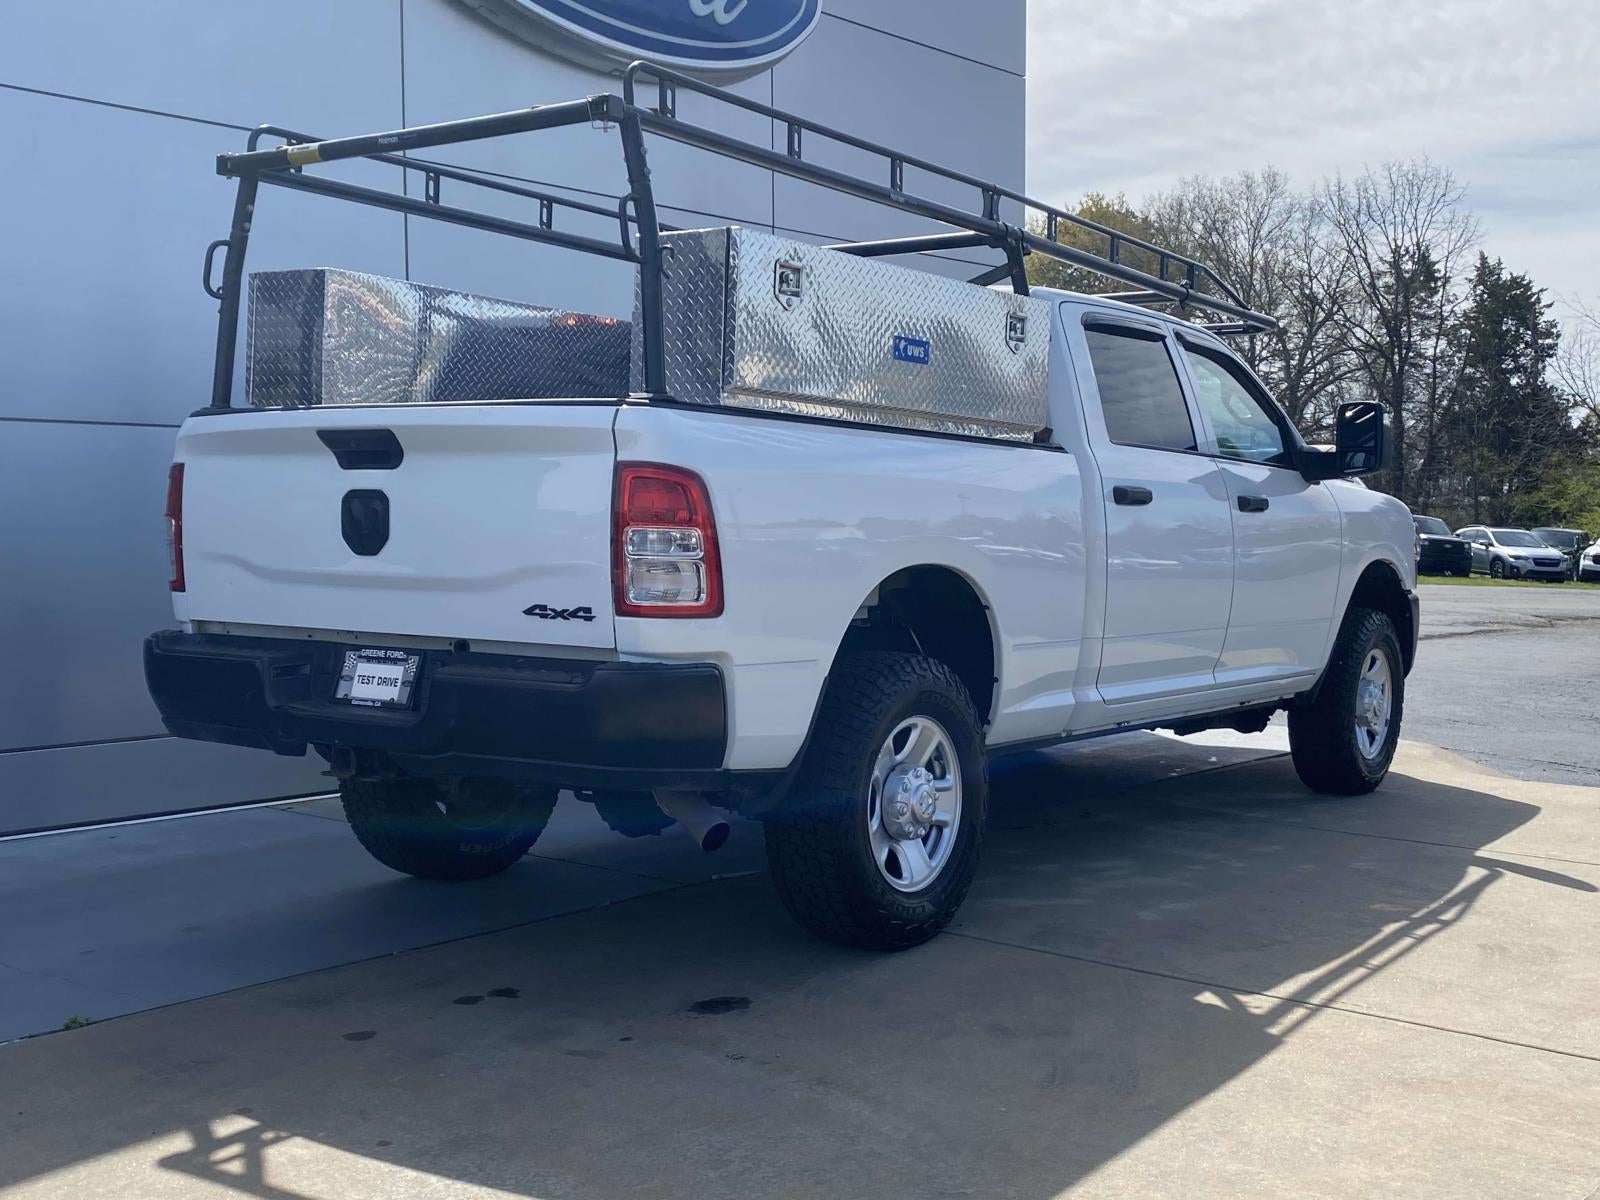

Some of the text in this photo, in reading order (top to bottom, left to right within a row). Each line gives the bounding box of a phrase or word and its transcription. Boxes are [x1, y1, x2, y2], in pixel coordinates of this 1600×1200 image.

[907, 344, 925, 358] UWS
[522, 603, 597, 622] 4x4
[361, 649, 404, 659] GREENE FORD
[357, 674, 399, 687] TEST DRIVE
